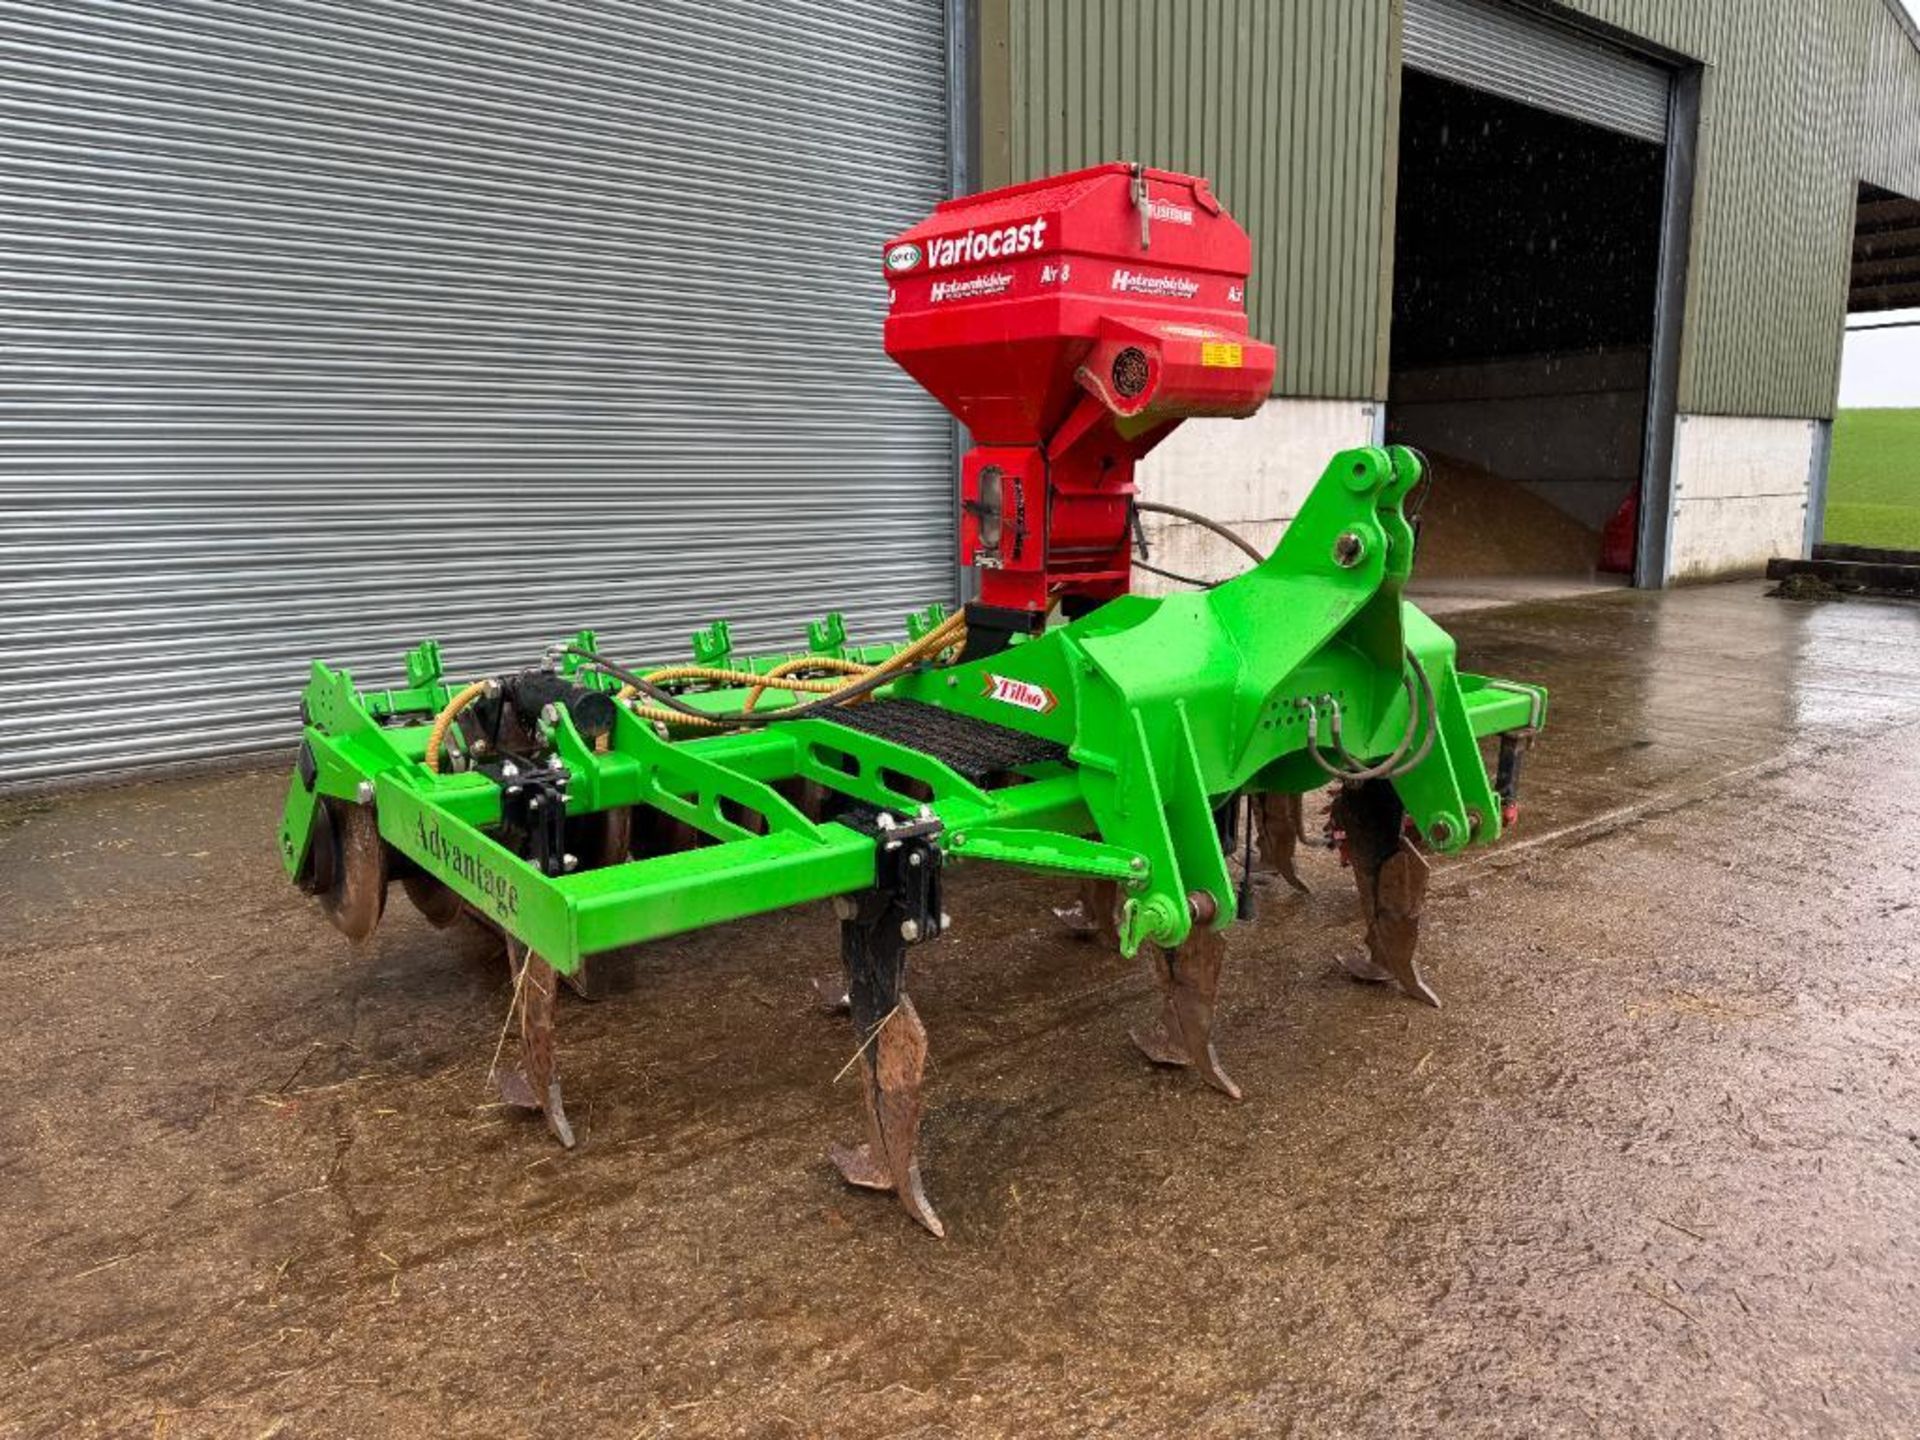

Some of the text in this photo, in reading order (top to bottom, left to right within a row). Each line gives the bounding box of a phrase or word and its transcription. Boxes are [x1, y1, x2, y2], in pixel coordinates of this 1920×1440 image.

[927, 216, 1047, 269] Variocast
[1061, 264, 1071, 282] 8
[416, 810, 519, 918] Advantage
